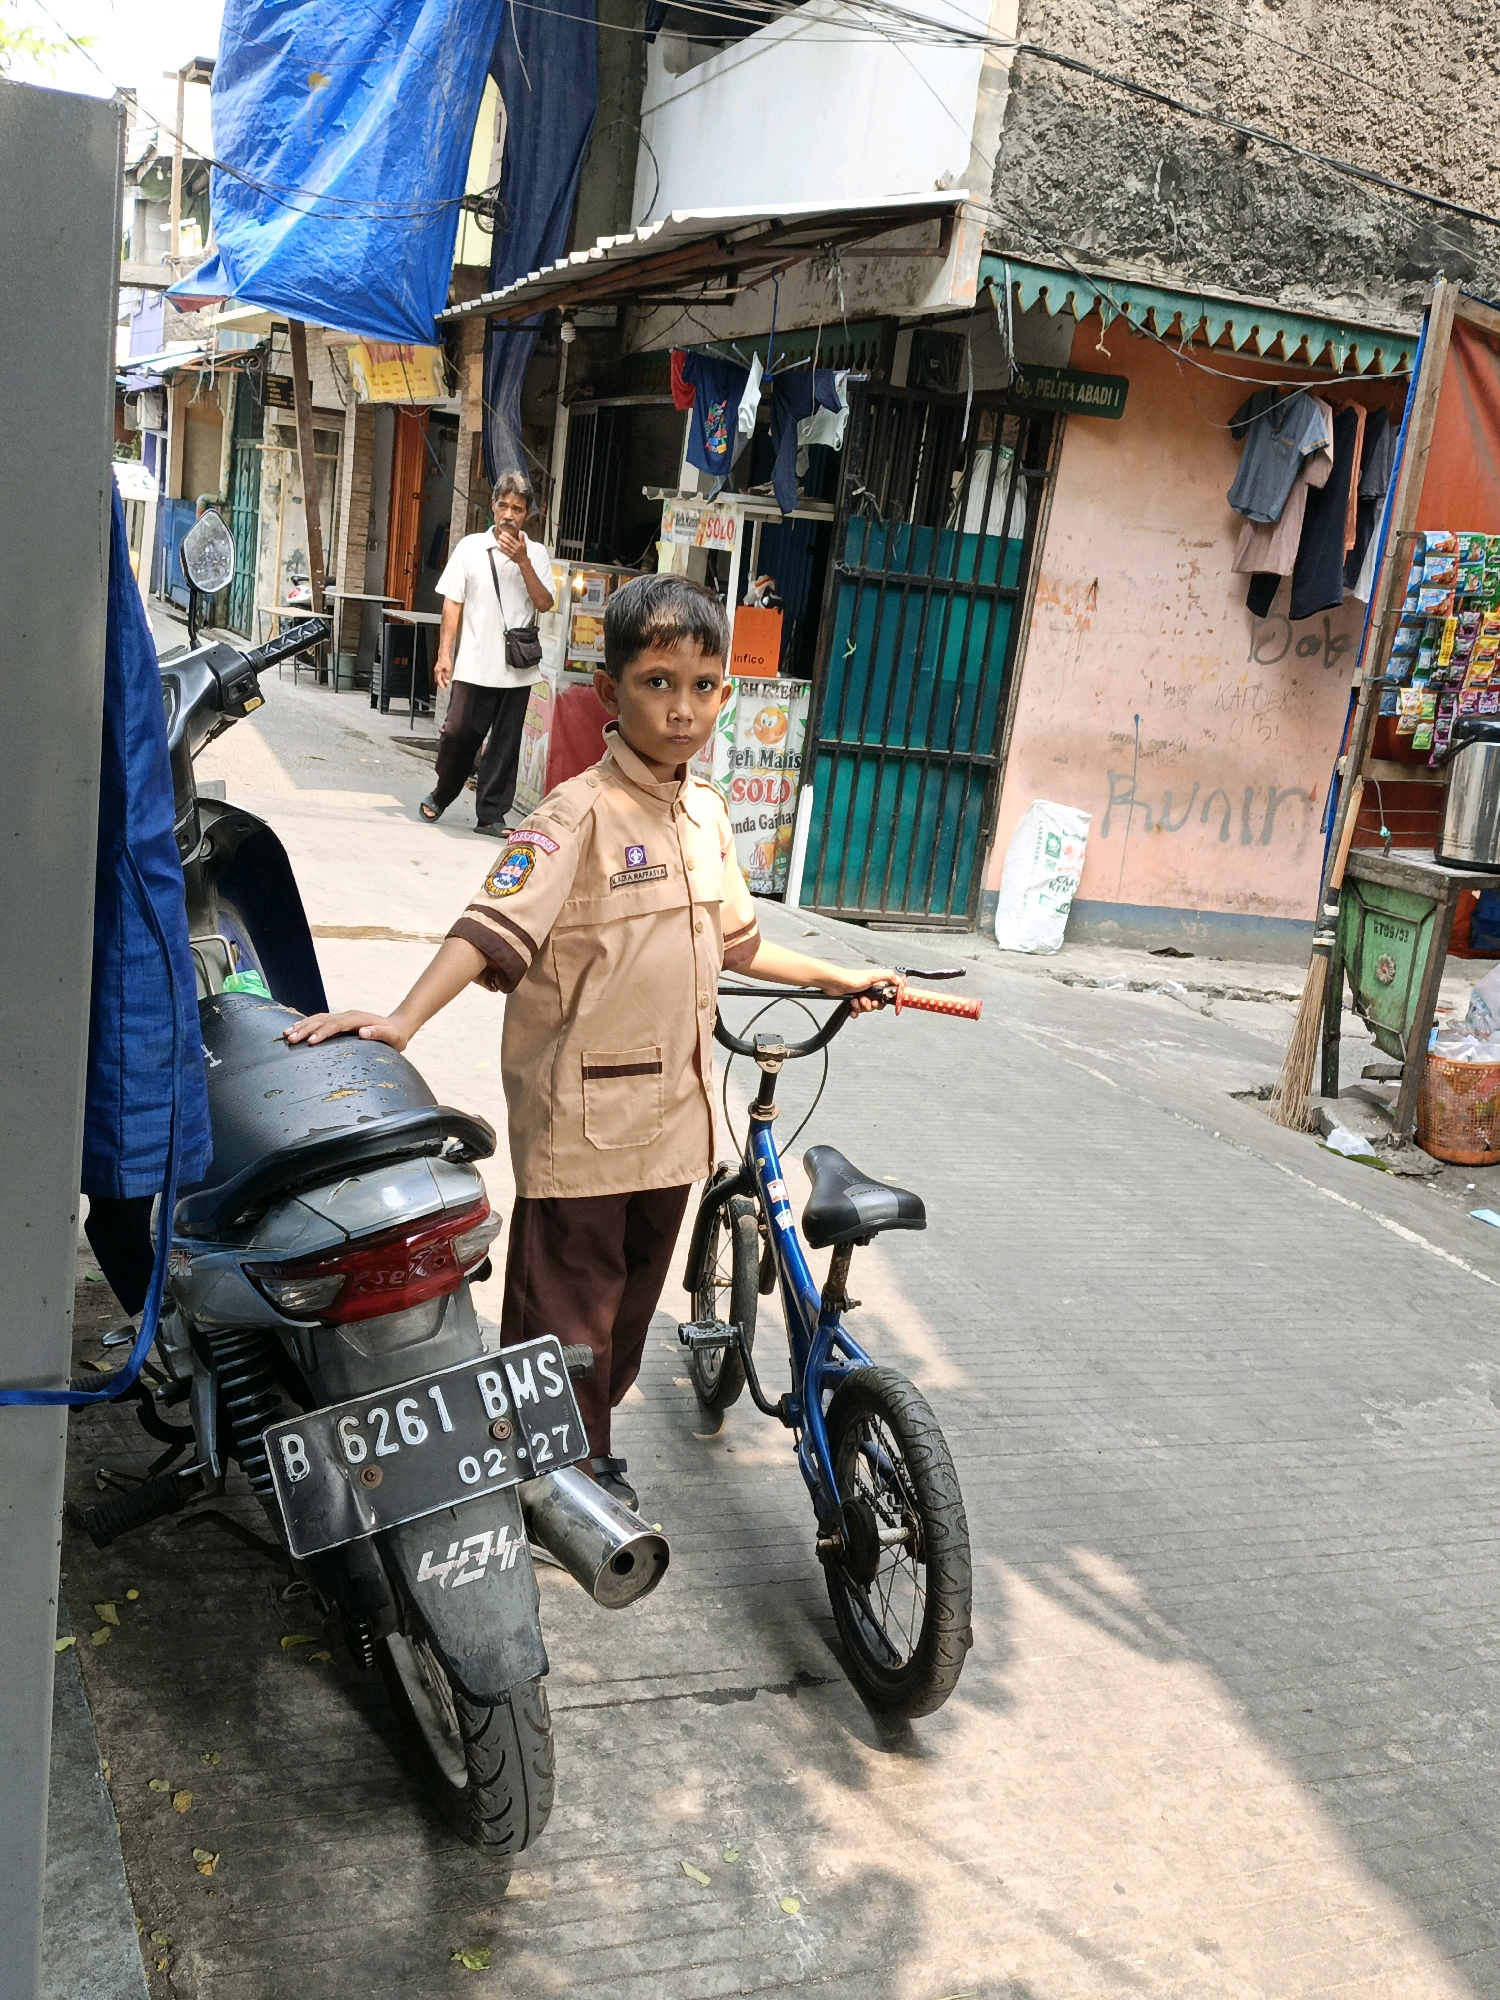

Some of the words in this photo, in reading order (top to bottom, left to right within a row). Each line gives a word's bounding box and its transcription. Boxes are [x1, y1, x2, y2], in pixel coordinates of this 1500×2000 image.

[1035, 370, 1074, 401] PELITA
[1076, 384, 1113, 406] ABADI
[1113, 388, 1120, 406] I
[705, 515, 735, 541] SOLO
[727, 747, 755, 769] Teh
[730, 776, 792, 805] SOLO
[633, 868, 665, 880] RAFFASYA
[278, 1432, 311, 1483] B
[337, 1384, 455, 1465] 6261
[476, 1351, 564, 1420] BMS
